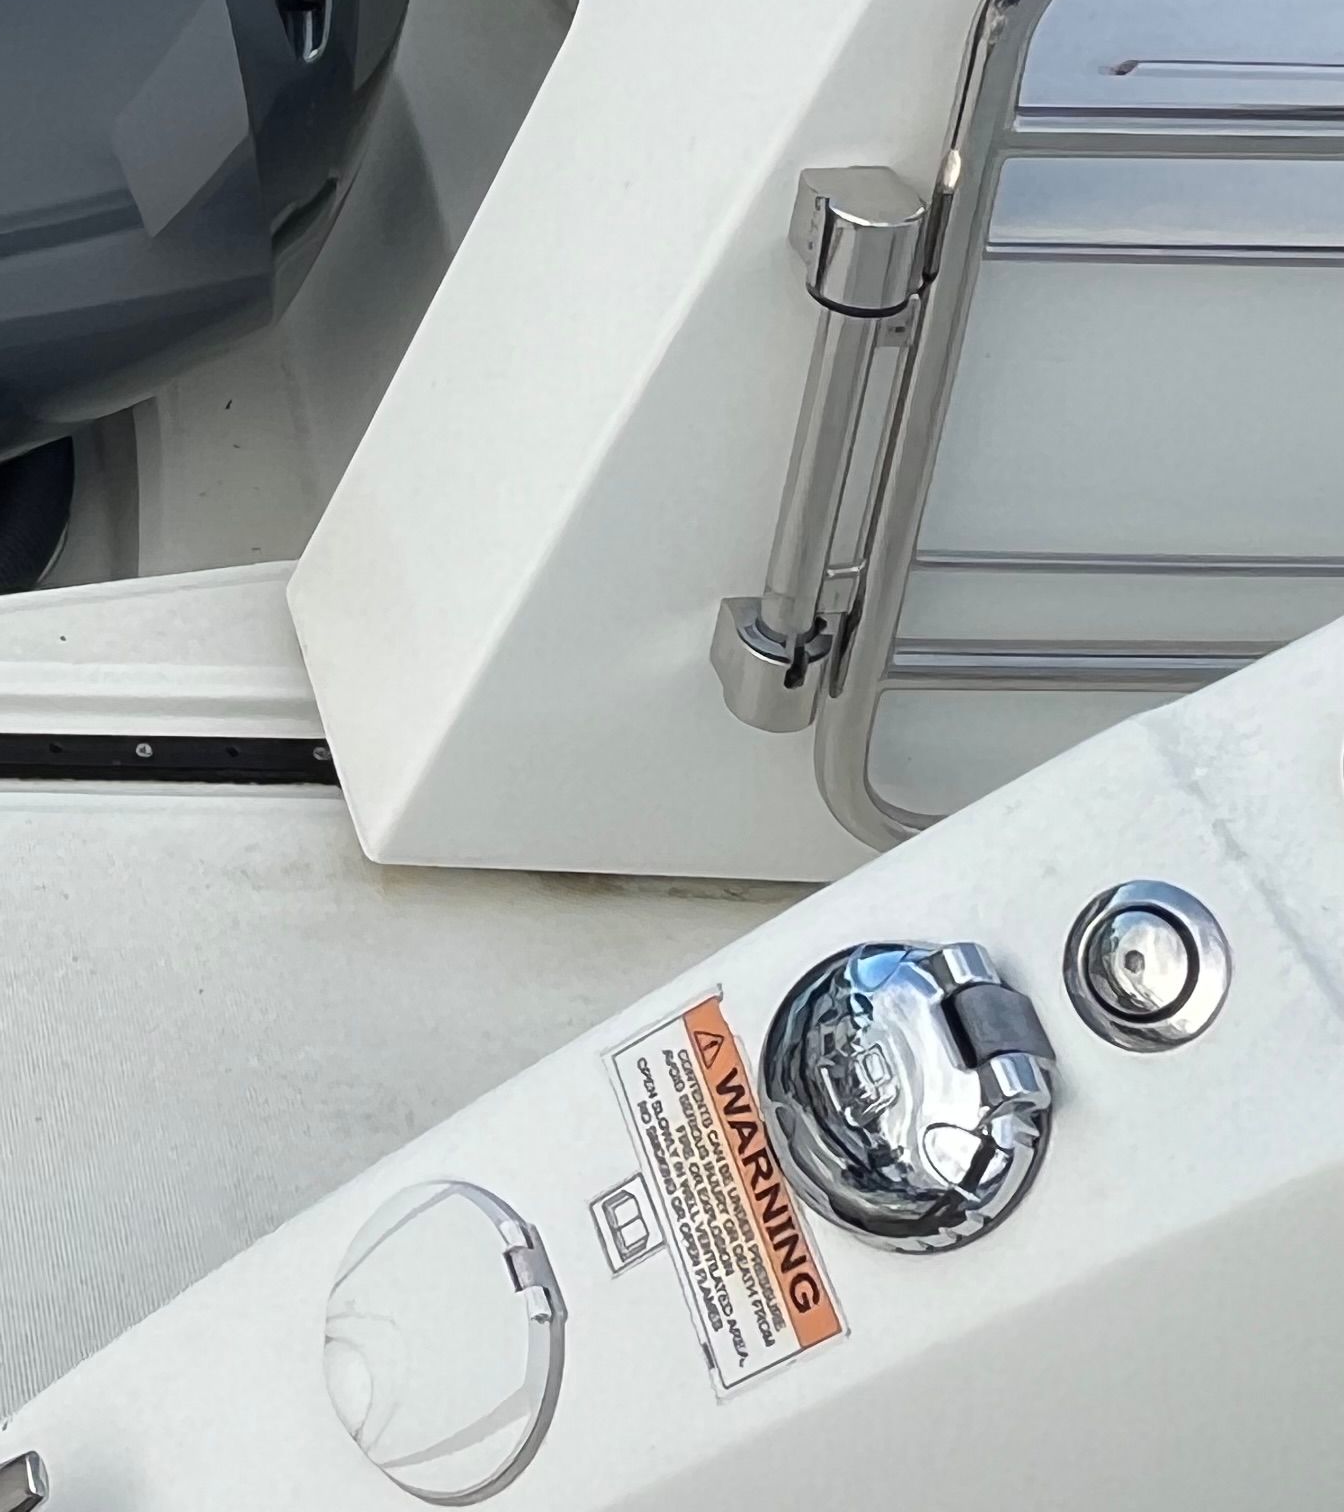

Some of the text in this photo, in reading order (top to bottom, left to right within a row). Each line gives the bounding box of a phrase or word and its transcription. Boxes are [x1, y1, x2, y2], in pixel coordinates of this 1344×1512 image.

[635, 1099, 654, 1125] NO
[685, 1160, 705, 1190] OR
[634, 1056, 659, 1100] OPEN
[649, 1099, 681, 1161] SLOWLY
[677, 1177, 702, 1223] WELL
[691, 1220, 735, 1317] VENTILATED
[660, 1047, 777, 1348] AVOID SERIOUS INJURY OR DEATH FROM
[668, 1195, 688, 1223] OR
[675, 1048, 714, 1129] CONTENTS
[705, 1128, 727, 1163] CAN
[725, 1185, 756, 1243] UNDER
[746, 1242, 787, 1332] PRESSURE
[677, 1221, 703, 1268] OPEN
[714, 1067, 822, 1314] WARNING
